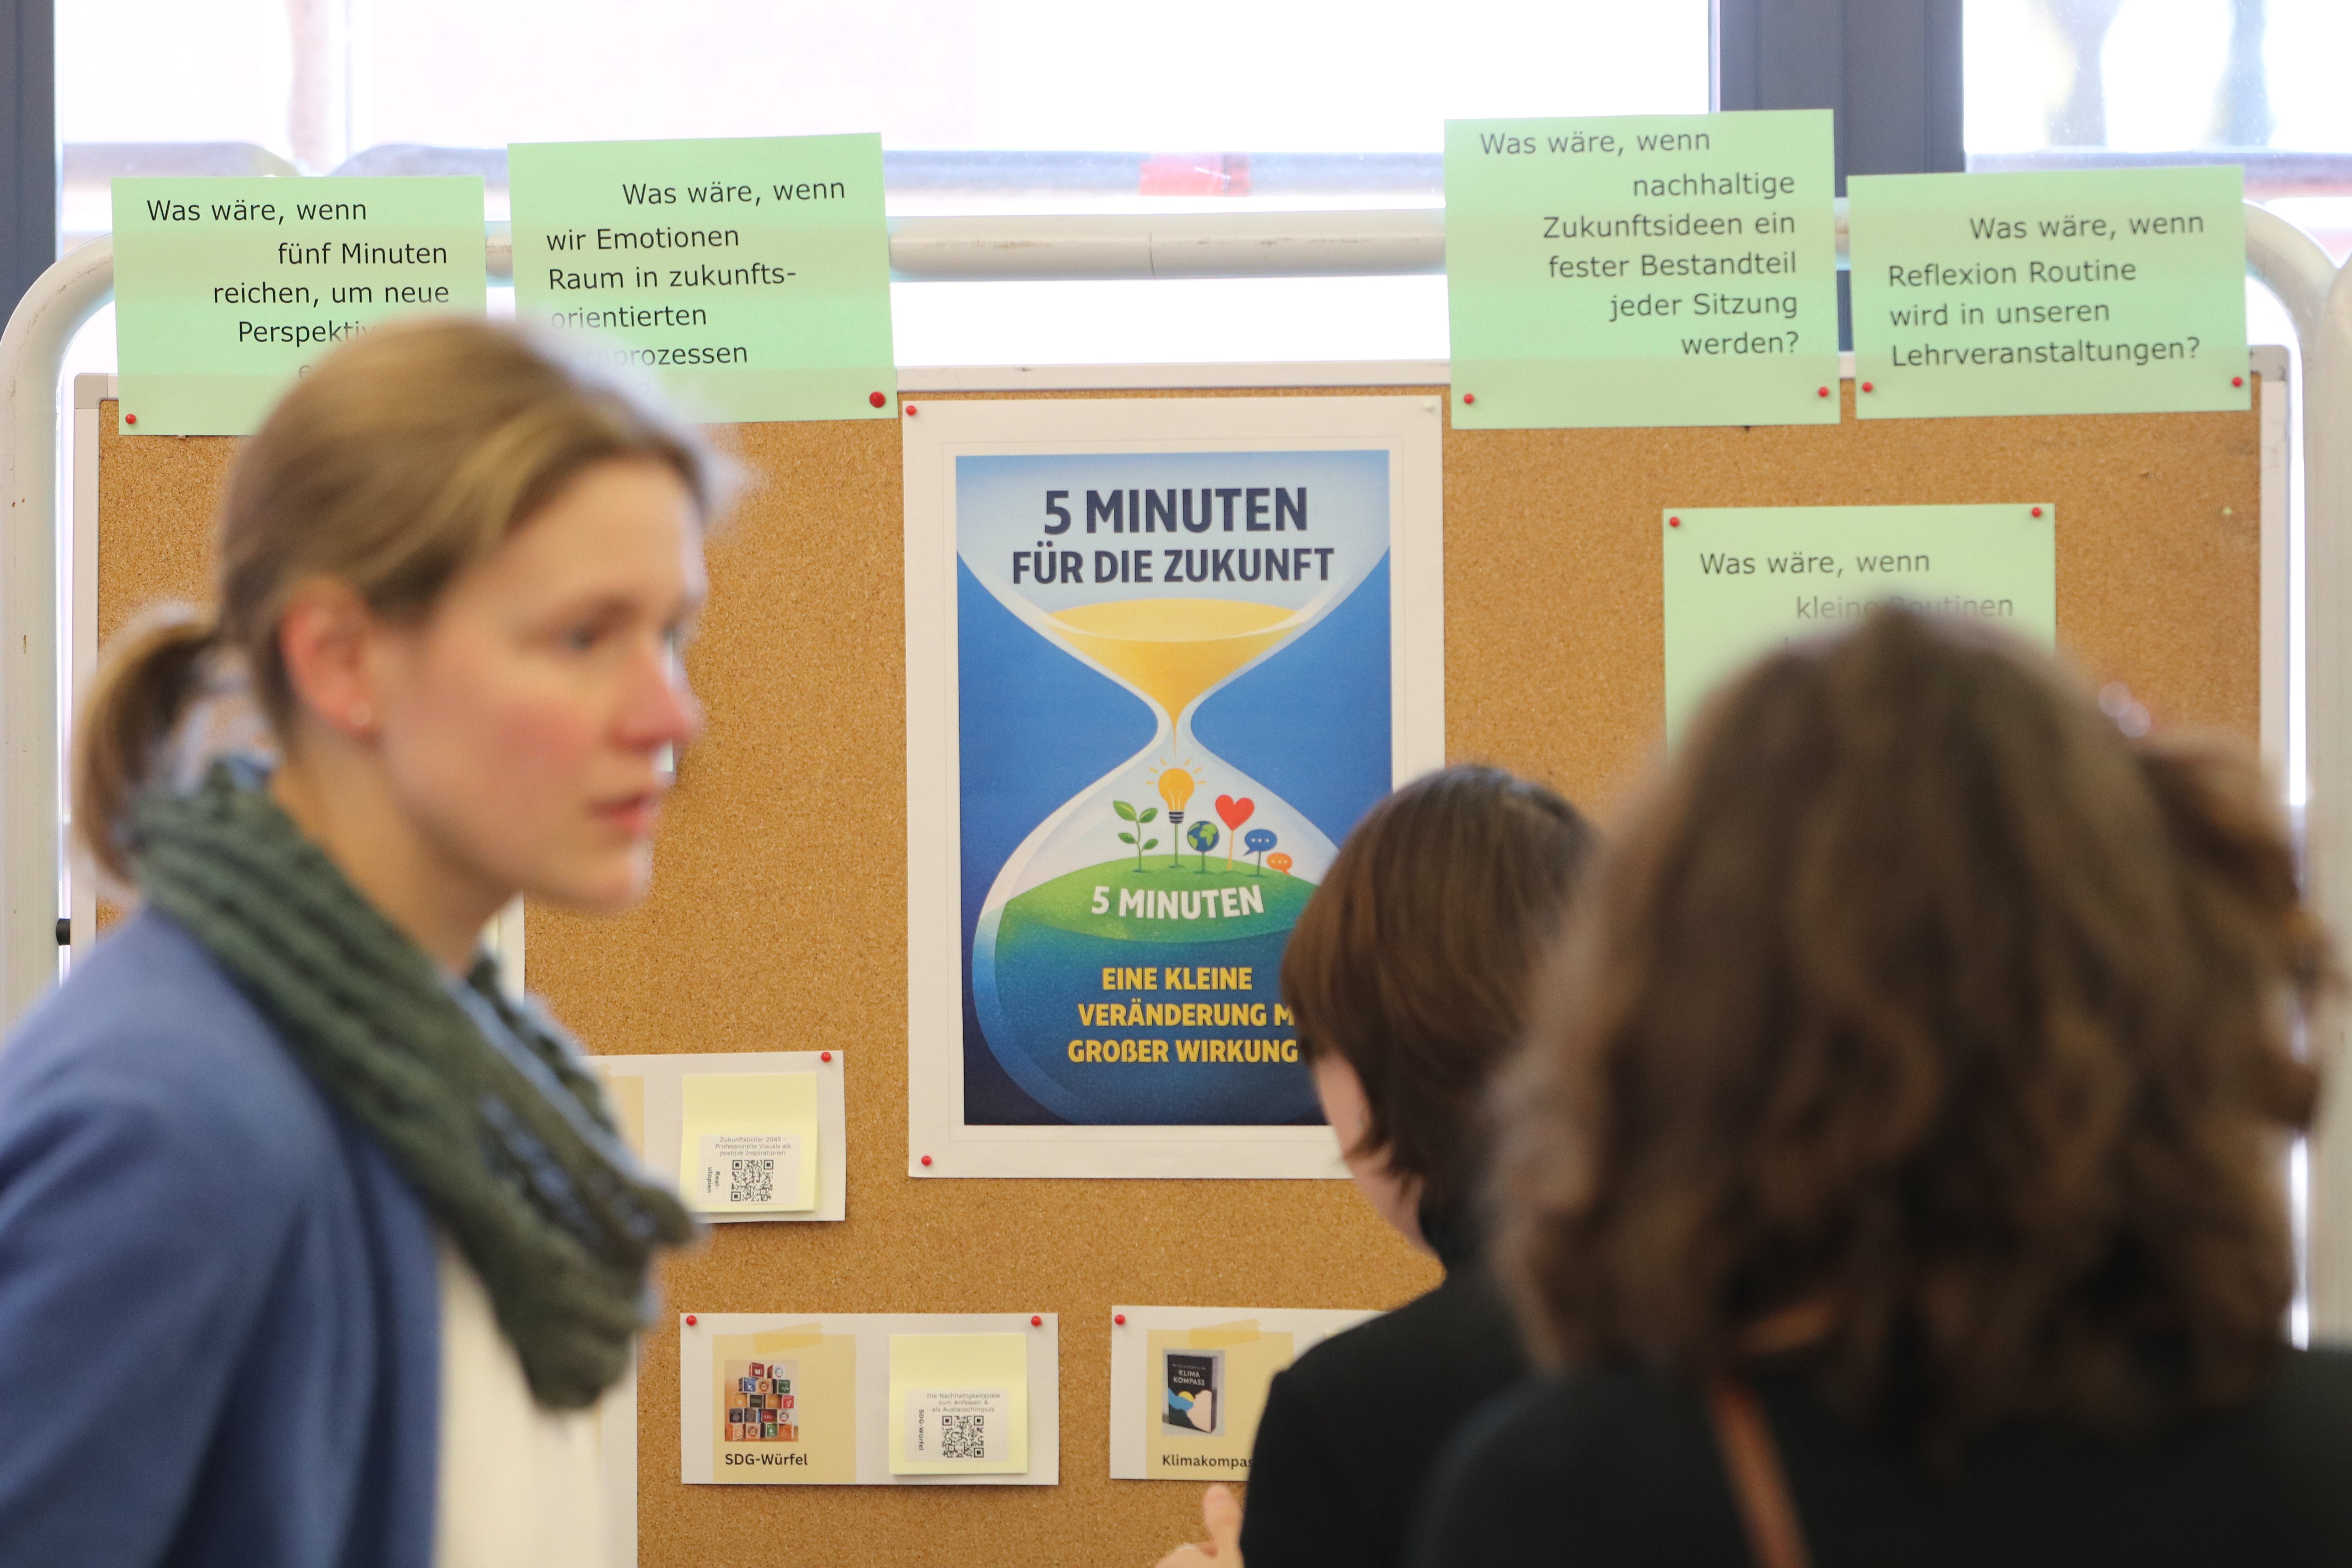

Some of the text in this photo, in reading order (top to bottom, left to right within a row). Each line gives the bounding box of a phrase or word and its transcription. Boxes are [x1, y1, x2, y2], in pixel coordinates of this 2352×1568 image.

[1480, 131, 1710, 157] Was wäre, wenn
[622, 181, 845, 207] Was wäre, wenn
[1633, 172, 1795, 200] nachhaltige
[146, 199, 367, 226] Was wäre, wenn
[1543, 212, 1795, 239] Zukunftsideen ein
[546, 226, 739, 251] wir Emotionen
[1969, 214, 2204, 241] Was wäre, wenn
[278, 242, 447, 265] fünf Minuten
[1549, 250, 1796, 278] fester Bestandteil
[549, 262, 796, 290] Raum in zukunfts-
[1889, 259, 2136, 287] Reflexion Routine
[214, 281, 449, 309] reichen, um neue
[1608, 292, 1797, 323] jeder Sitzung
[550, 305, 707, 330] orientierten
[1889, 303, 2110, 327] wird in unseren
[238, 319, 376, 348] Perspektiv
[1681, 330, 1799, 355] werden?
[1892, 336, 2200, 367] Lehrveranstaltungen?
[1044, 487, 1307, 535] 5 MINUTEN
[1013, 540, 1335, 585] FÜR DIE ZUKUNFT
[1700, 552, 1930, 578] Was wäre, wenn
[1797, 595, 1878, 619] kleine
[1091, 884, 1265, 920] 5 MINUTEN
[1102, 967, 1252, 990] EINE KLEINE
[1077, 998, 1268, 1027] VERÄNDERUNG
[1175, 1039, 1298, 1063] WIRKUNG
[1174, 1376, 1205, 1386] KOMPASS
[726, 1454, 808, 1465] SDG-Würfel
[1162, 1454, 1253, 1470] Klimakompas
